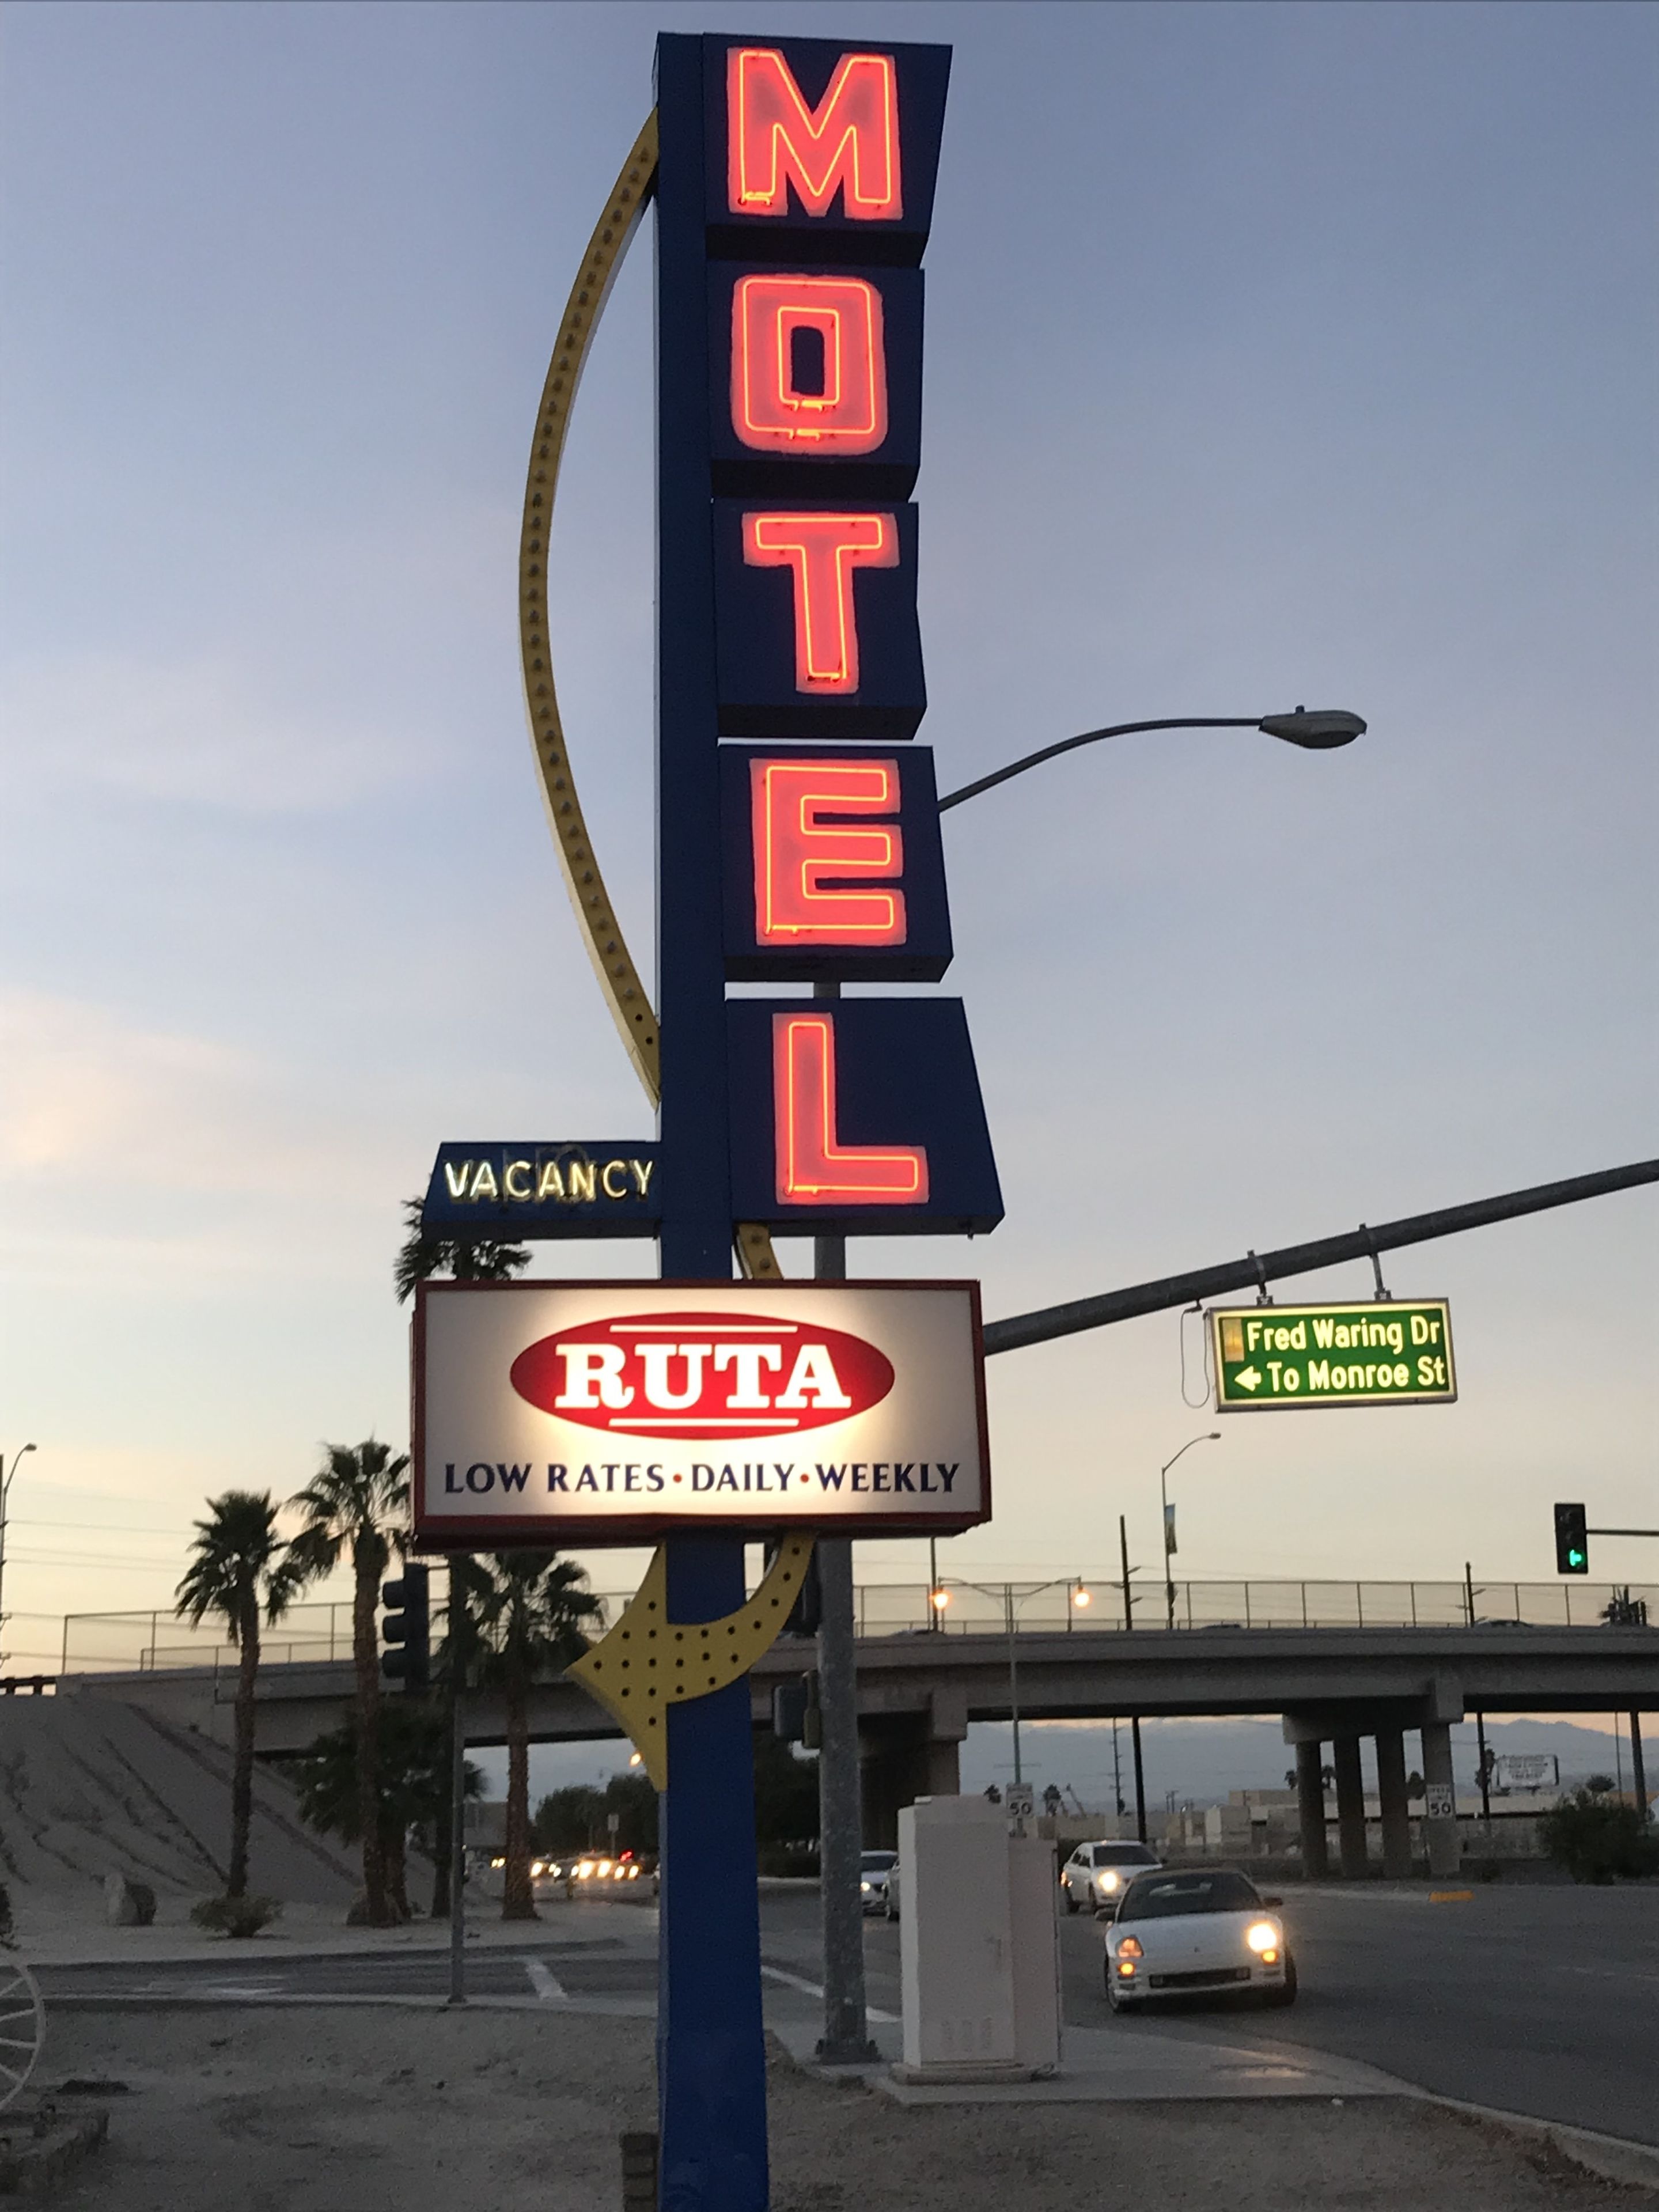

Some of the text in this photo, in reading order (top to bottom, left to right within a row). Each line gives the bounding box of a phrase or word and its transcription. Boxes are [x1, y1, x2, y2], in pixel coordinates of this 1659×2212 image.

[727, 47, 929, 1205] MOTEL
[444, 1159, 654, 1198] VACANCY
[1247, 1316, 1440, 1354] Fred Waring Dr
[554, 1343, 851, 1410] RUTA
[1267, 1356, 1445, 1392] To Monroe St
[445, 1463, 960, 1494] LOW RATES DAILY WEEKLY
[1010, 1802, 1031, 1815] 50
[1430, 1802, 1450, 1815] 50
